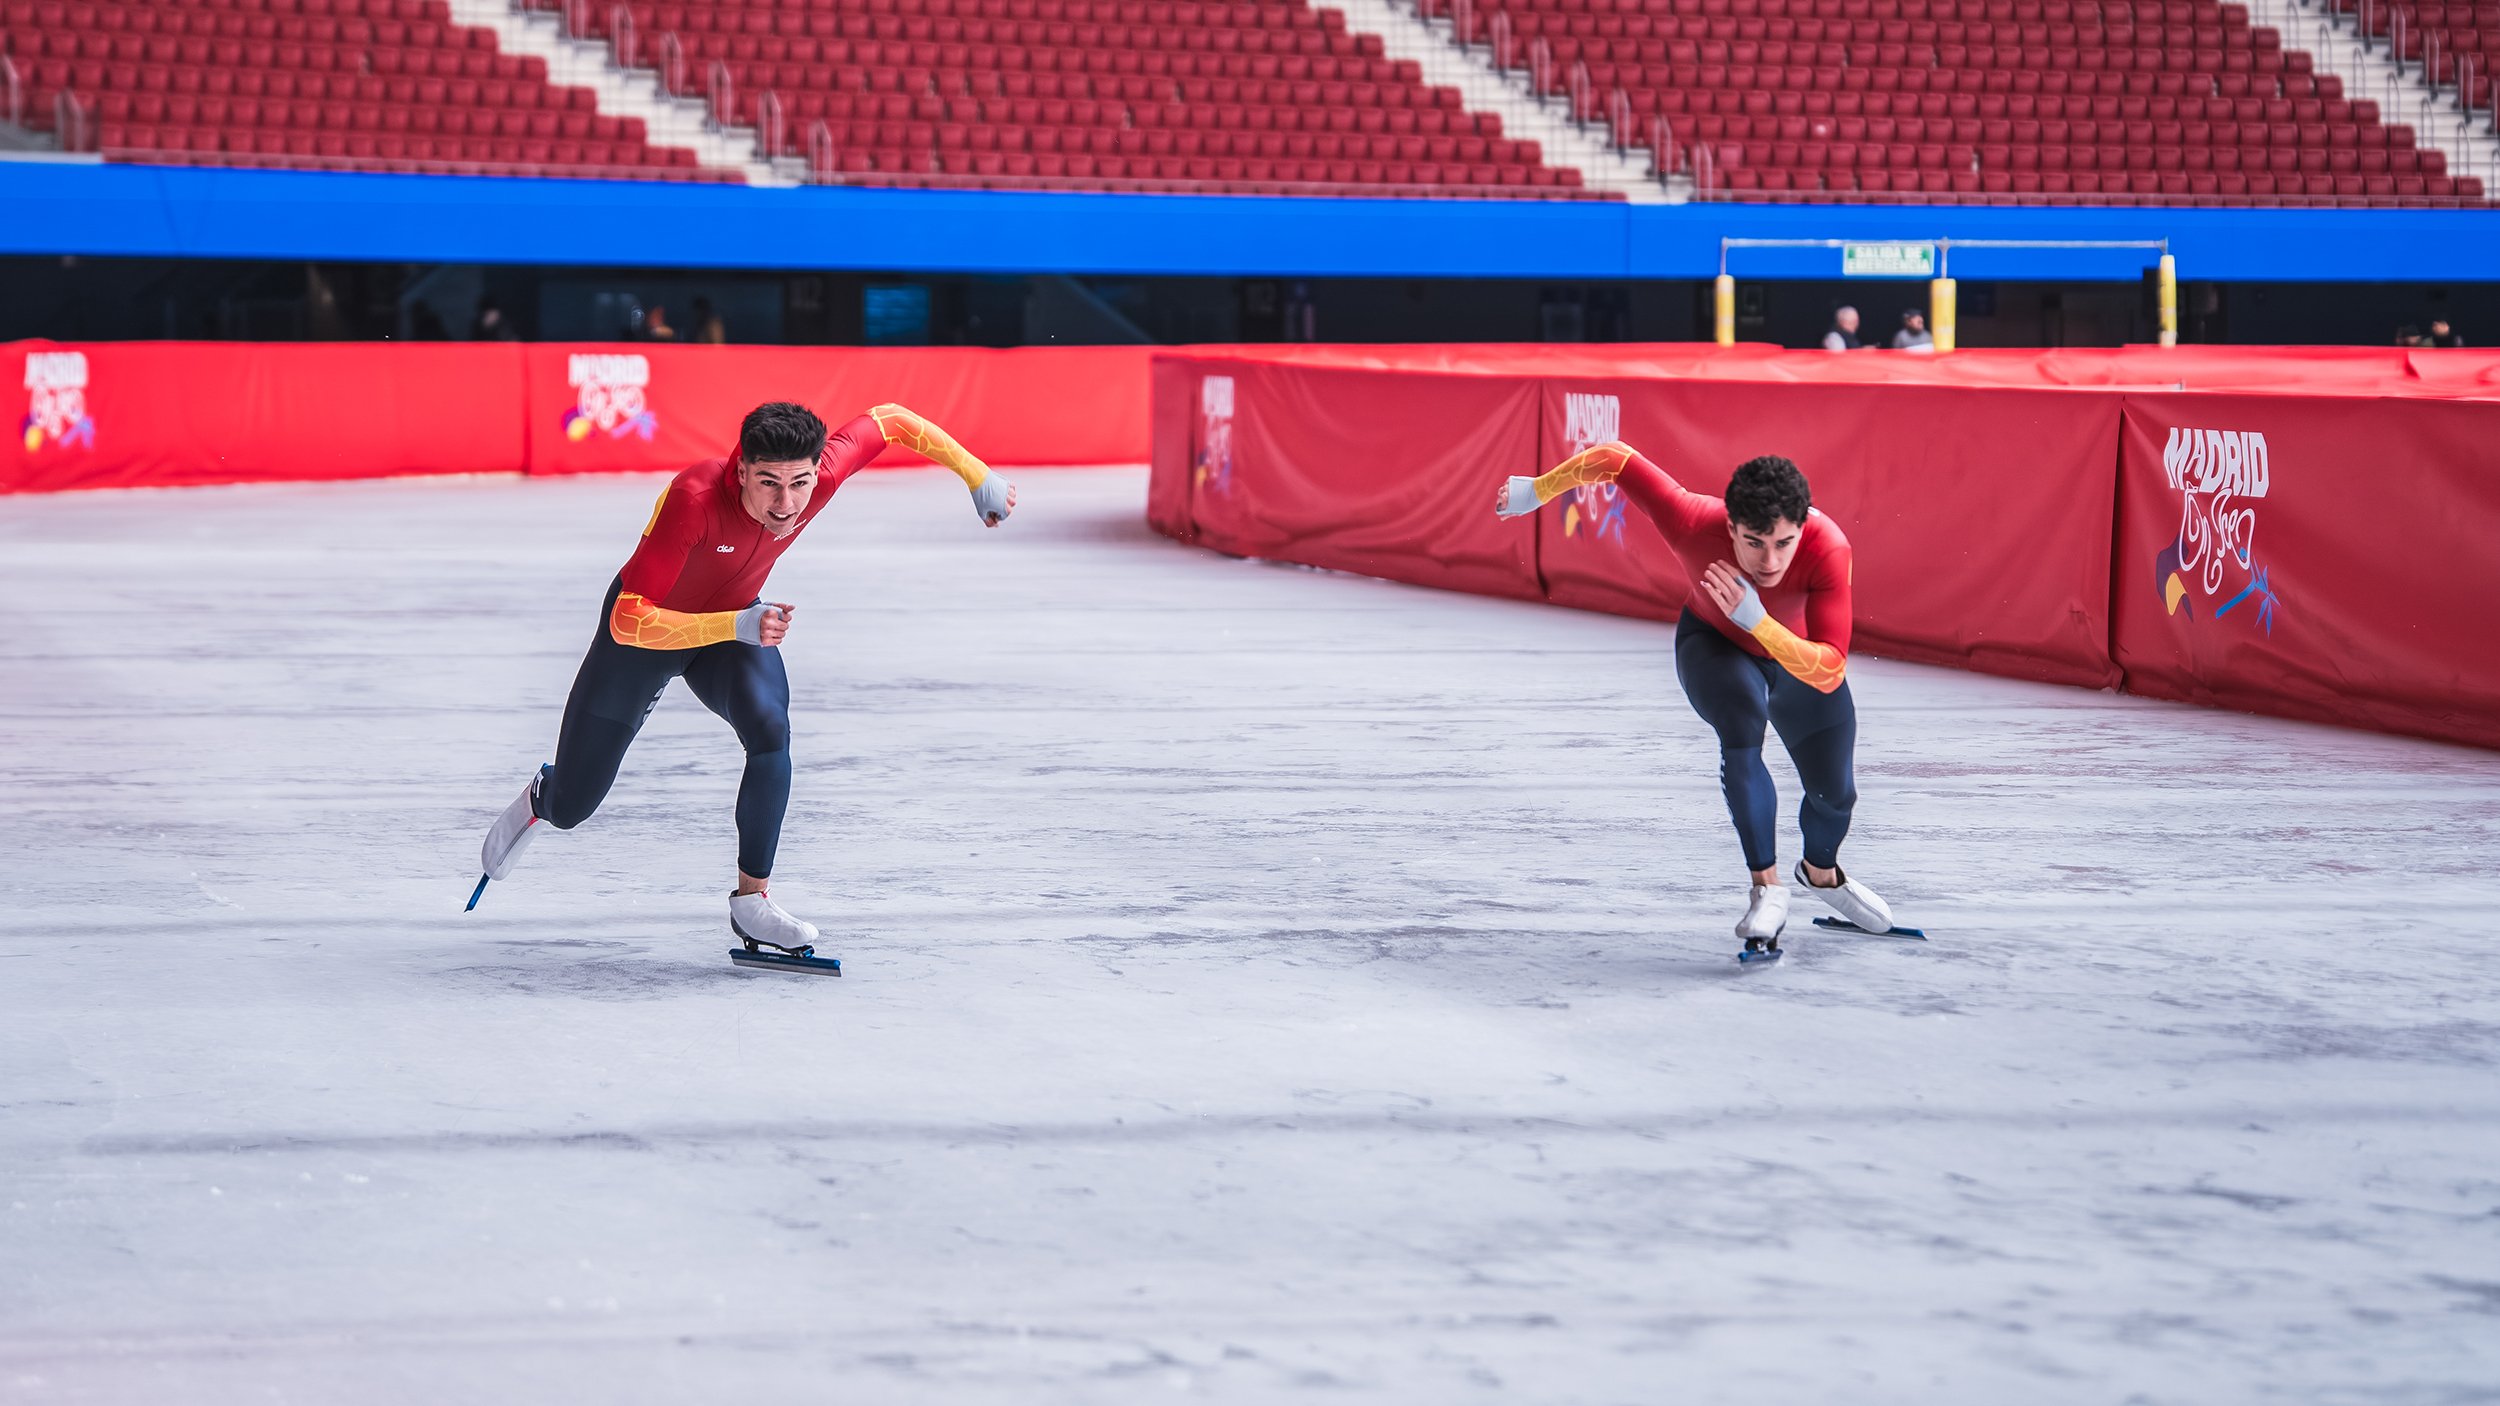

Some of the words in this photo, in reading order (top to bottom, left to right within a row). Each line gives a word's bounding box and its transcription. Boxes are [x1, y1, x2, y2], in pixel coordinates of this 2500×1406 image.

[1848, 259, 1930, 272] EMERGENCIA
[1856, 245, 1903, 258] SALIDA
[1566, 392, 1620, 443] MADRID
[2164, 427, 2269, 498] MADRID
